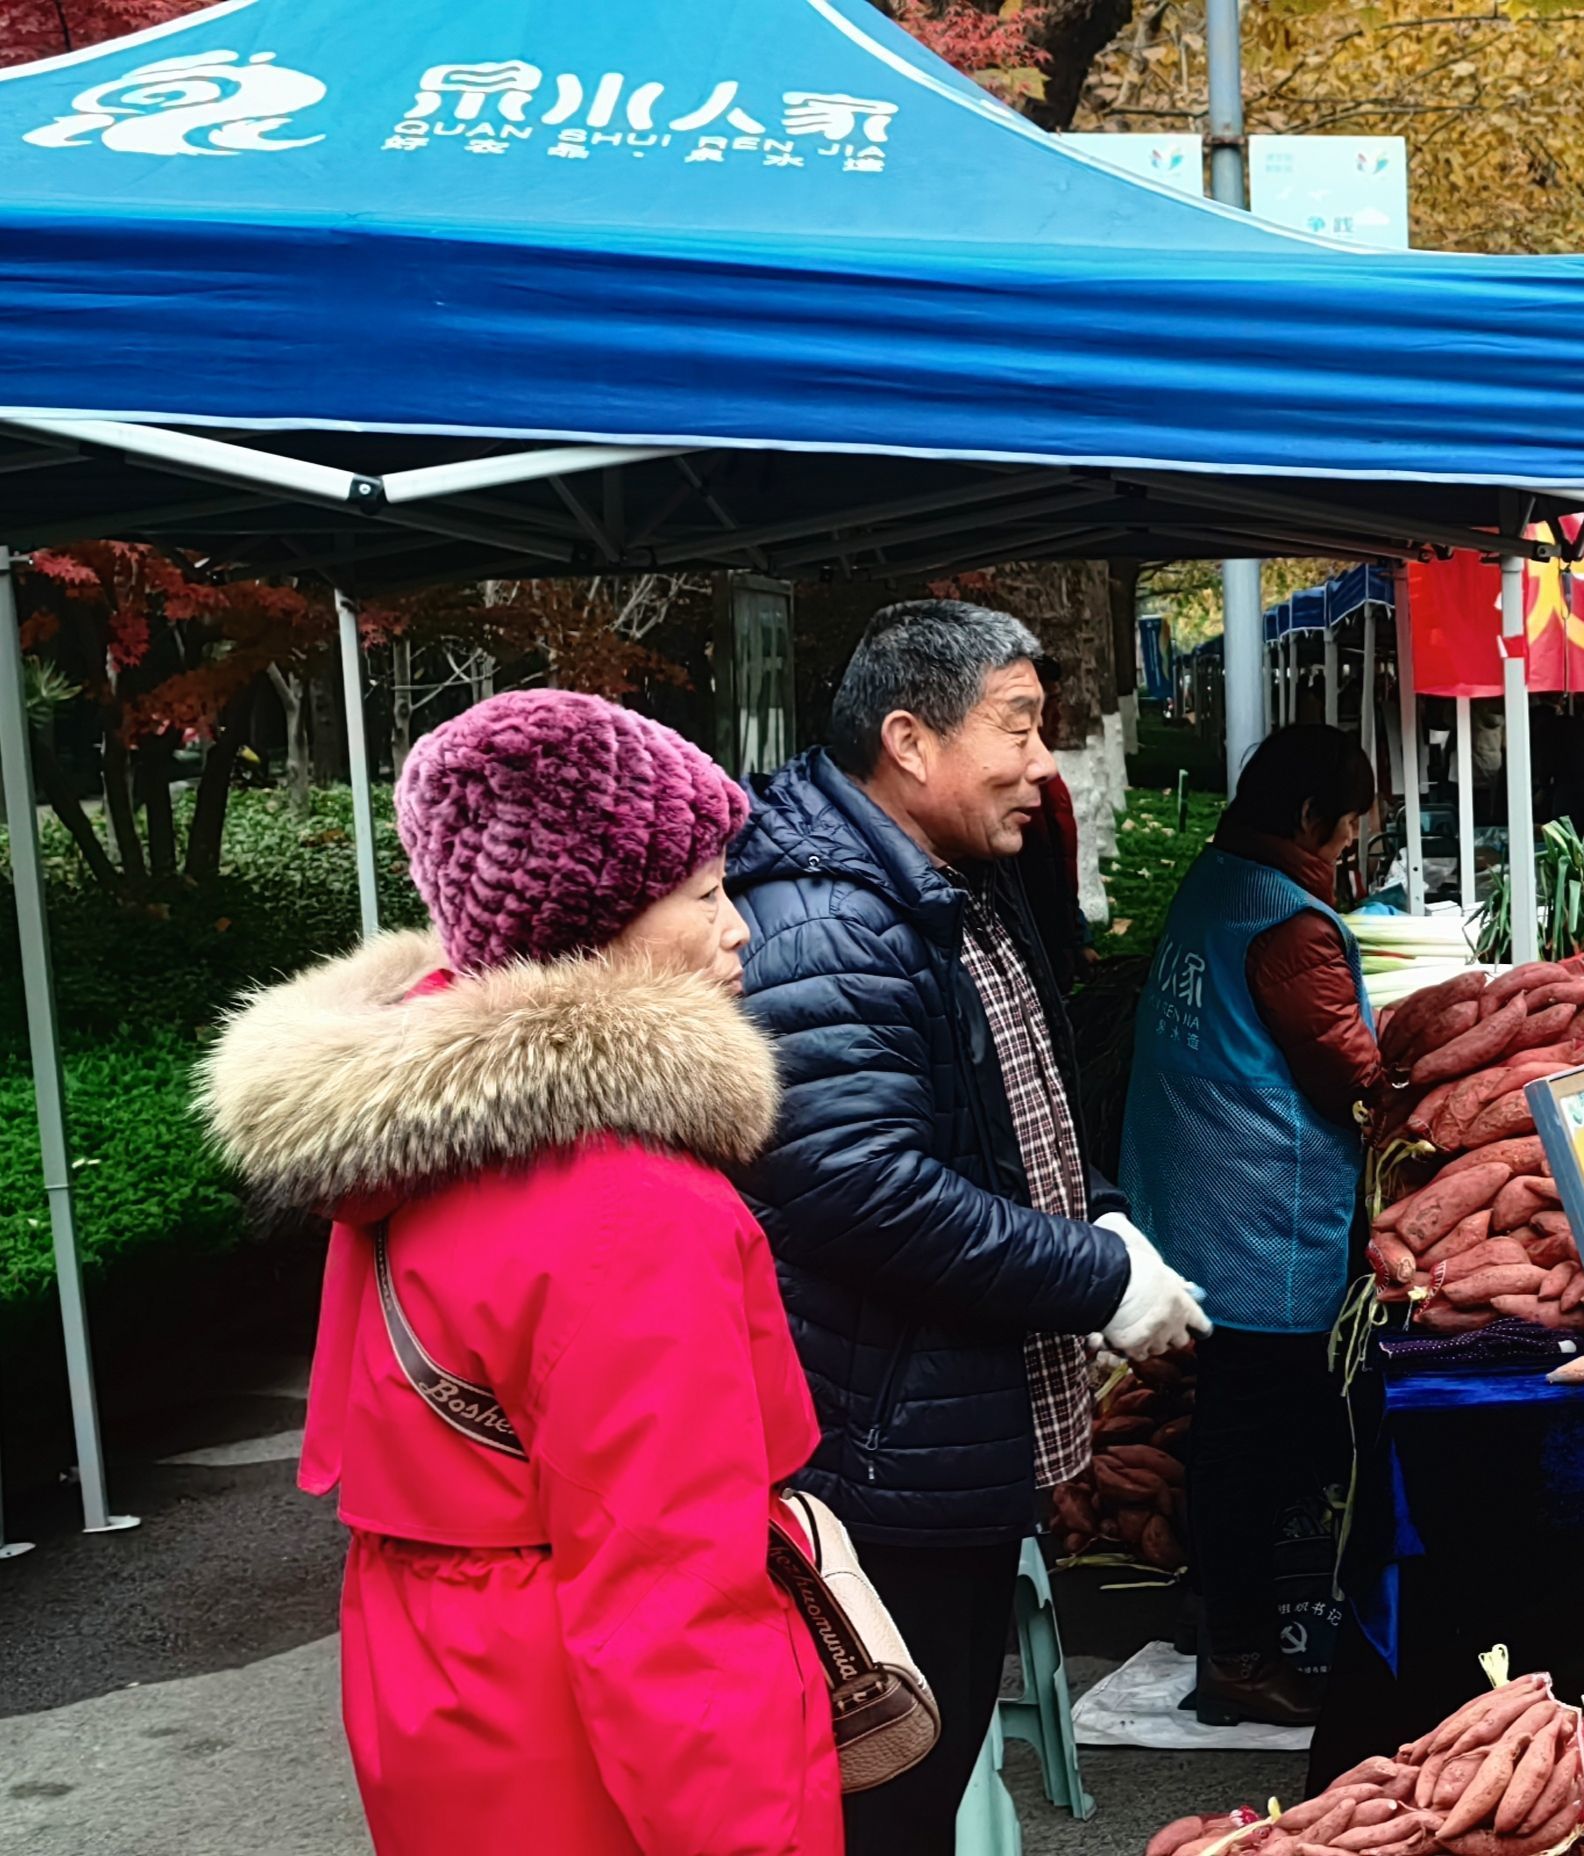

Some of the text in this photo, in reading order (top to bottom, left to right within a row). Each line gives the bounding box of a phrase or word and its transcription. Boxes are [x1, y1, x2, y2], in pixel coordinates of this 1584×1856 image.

[404, 60, 899, 142] 泉水人家
[394, 120, 885, 158] QUAN SHUI REN JIA
[419, 1379, 515, 1434] Boshe
